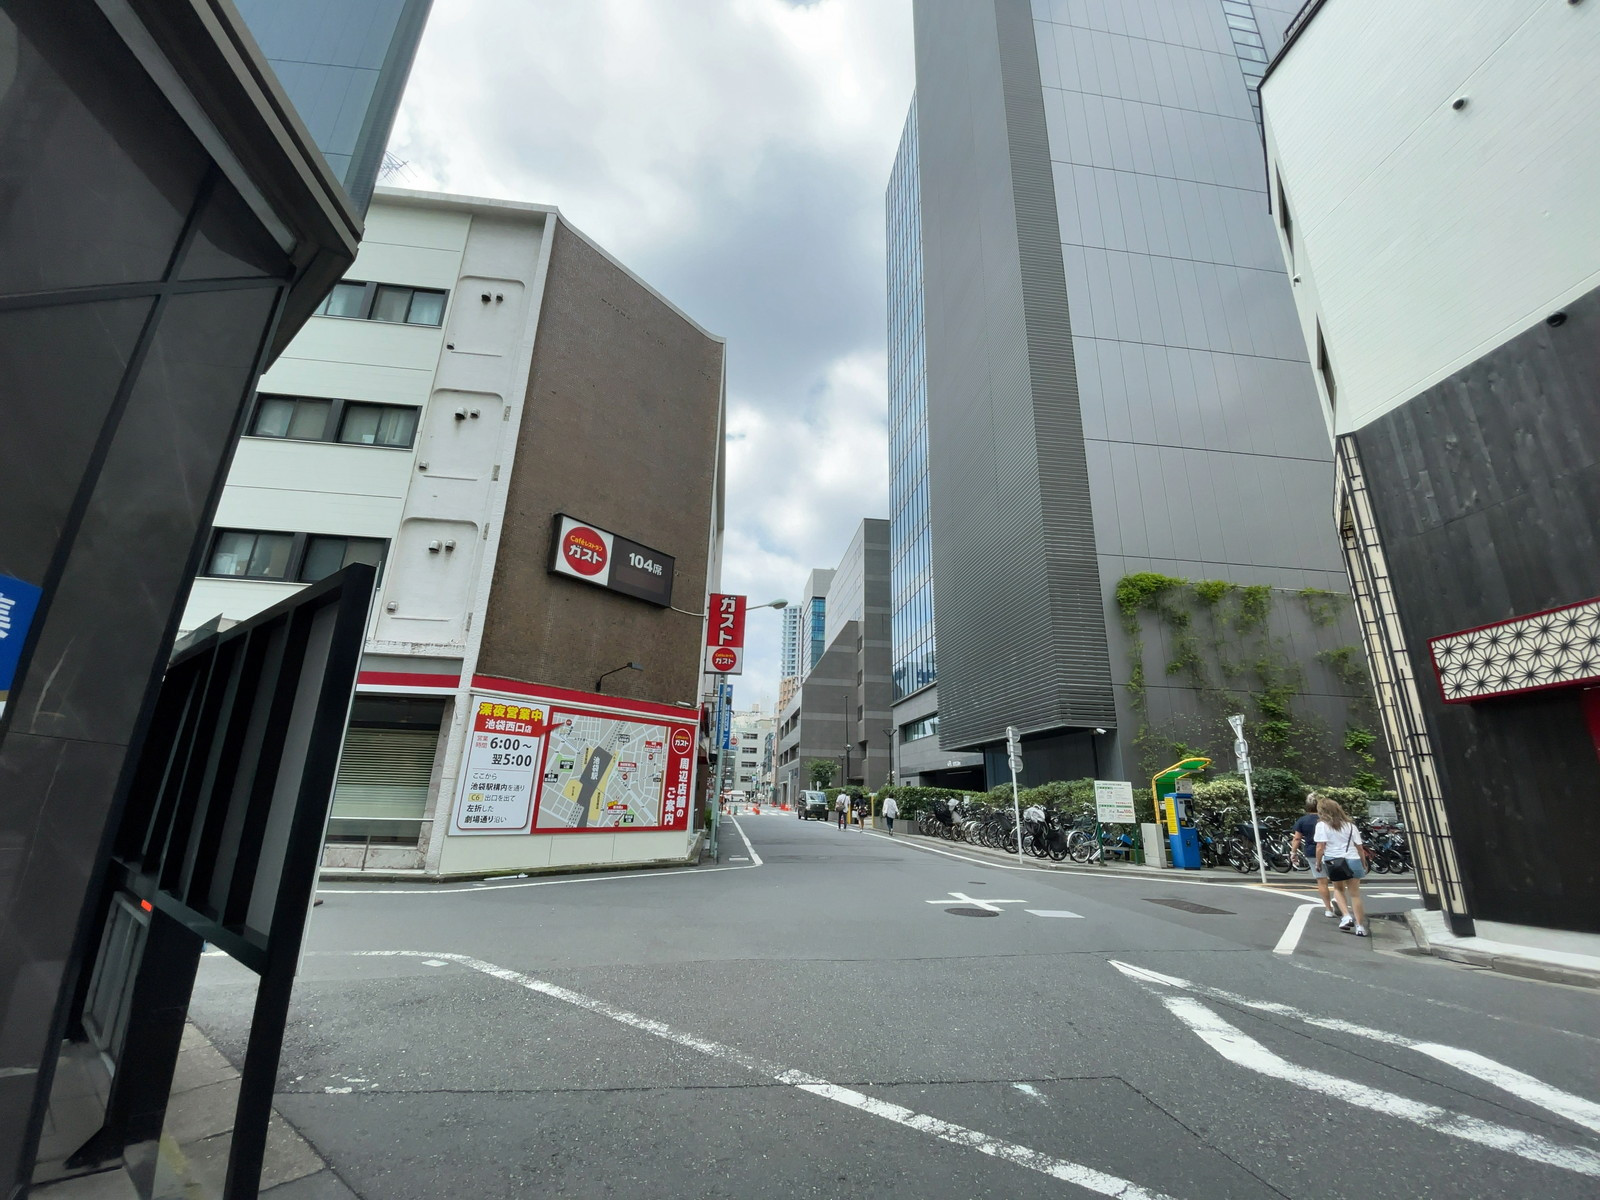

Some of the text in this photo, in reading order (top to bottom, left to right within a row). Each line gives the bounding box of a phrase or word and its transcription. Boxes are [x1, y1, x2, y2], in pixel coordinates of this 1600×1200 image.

[568, 544, 603, 565] ガスト
[628, 552, 663, 576] 104席
[718, 596, 736, 645] ガスト
[479, 702, 543, 722] 深夜営業中
[485, 718, 533, 734] 池袋西口店
[674, 739, 689, 747] ガスト
[491, 753, 532, 767] 翌5:00
[472, 772, 498, 780] ここから
[470, 782, 525, 792] 池袋駅構内を通り
[676, 757, 690, 818] 周辺店舗の
[484, 794, 516, 802] 出口を出て
[466, 804, 494, 813] 左折した
[663, 787, 676, 826] ご案内
[464, 815, 507, 824] 劇場通り沿い
